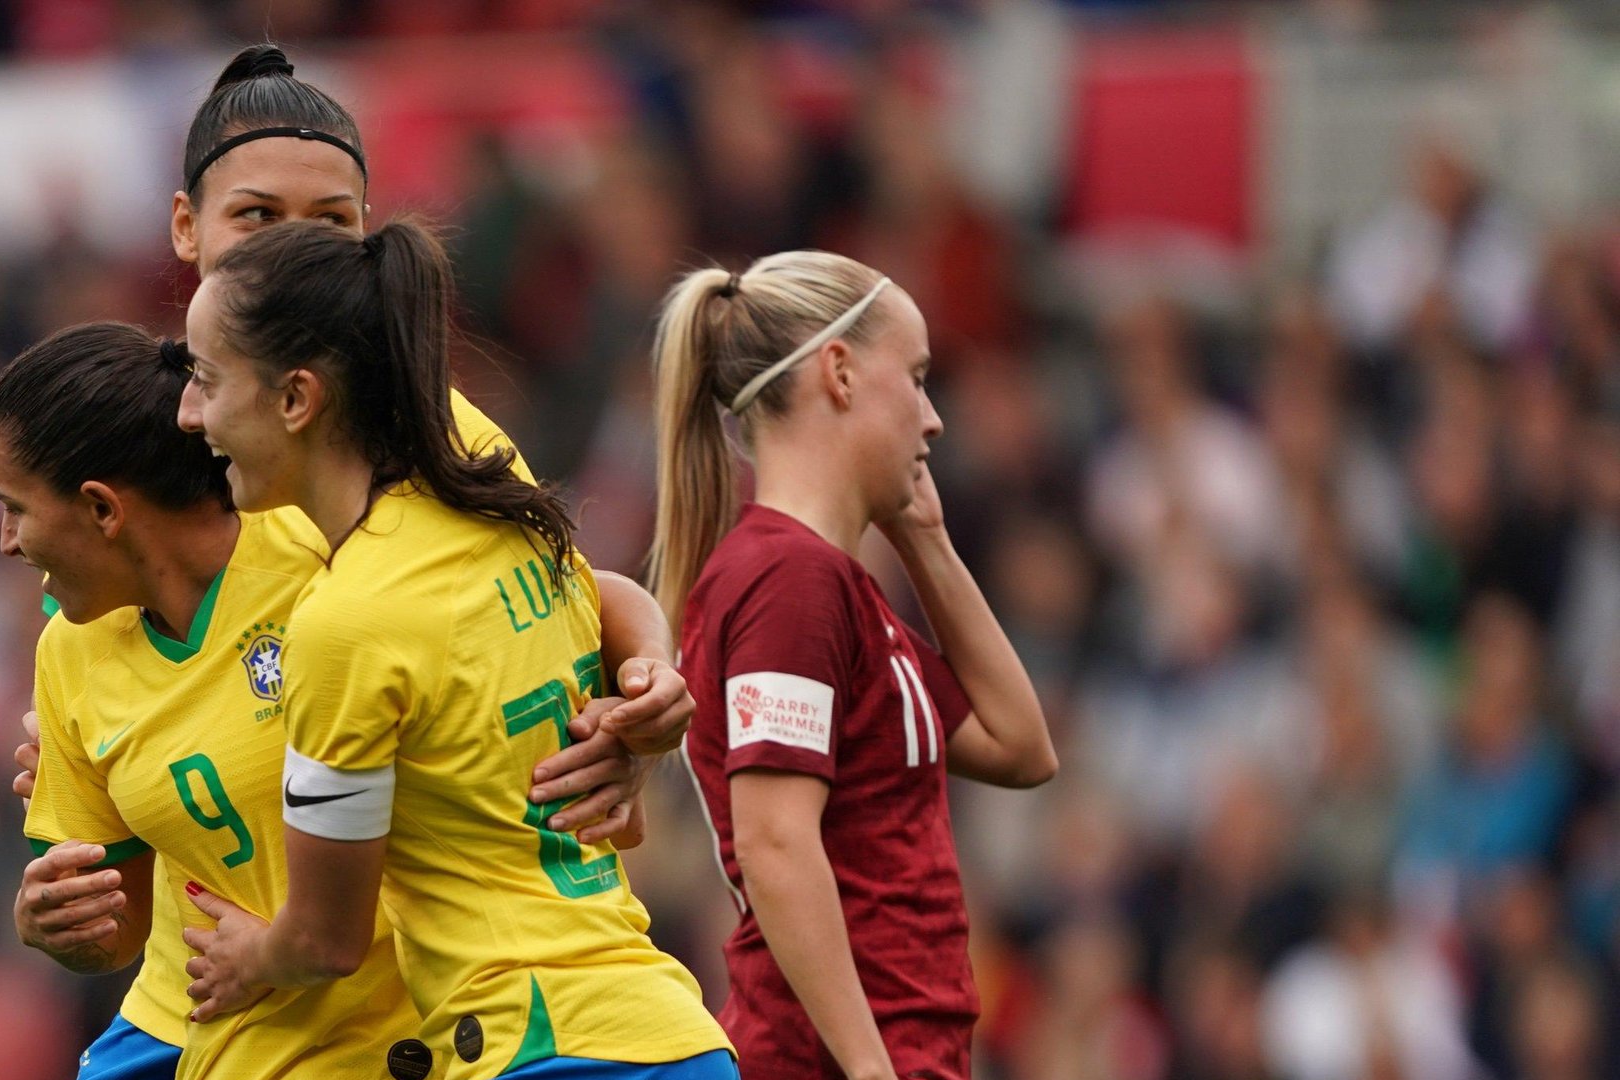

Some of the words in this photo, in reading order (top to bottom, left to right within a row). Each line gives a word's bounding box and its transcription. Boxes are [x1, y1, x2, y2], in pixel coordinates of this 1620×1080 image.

[262, 662, 277, 672] CBF
[255, 705, 283, 722] BRA
[763, 696, 819, 717] DARBY
[890, 655, 937, 767] 11
[763, 711, 826, 734] RIMMER
[168, 753, 255, 869] 9
